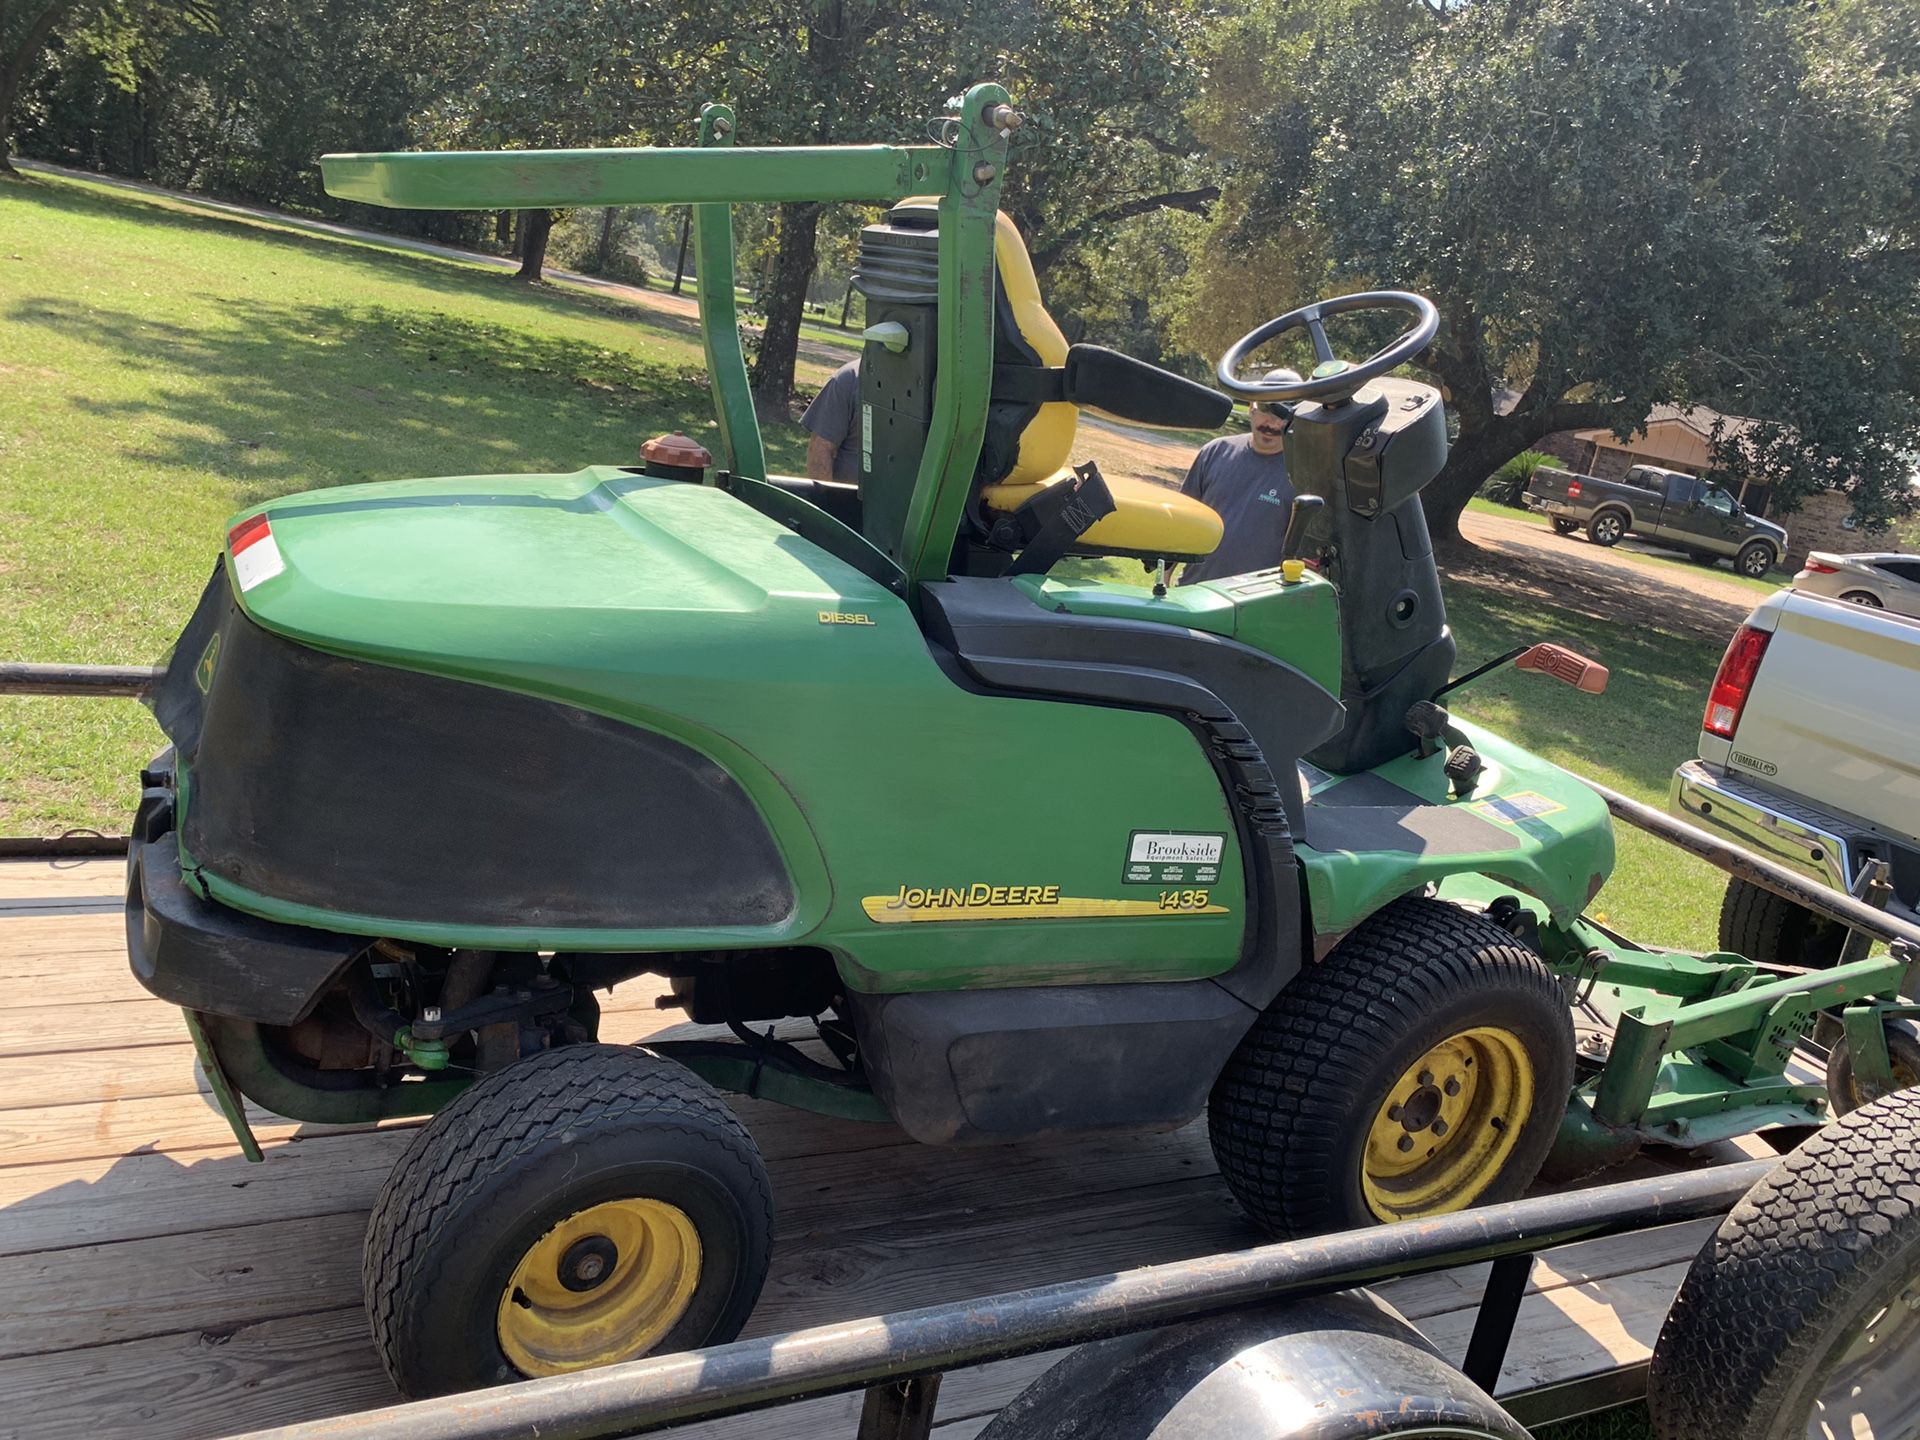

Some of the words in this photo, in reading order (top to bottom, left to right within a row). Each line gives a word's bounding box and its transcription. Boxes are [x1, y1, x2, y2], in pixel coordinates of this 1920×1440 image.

[818, 611, 876, 625] DIESEL
[1734, 753, 1763, 770] TOMBALL
[1147, 841, 1217, 856] Brookside
[887, 884, 966, 908] JOHN
[968, 882, 1061, 906] DEERE
[1159, 889, 1209, 909] 1435
